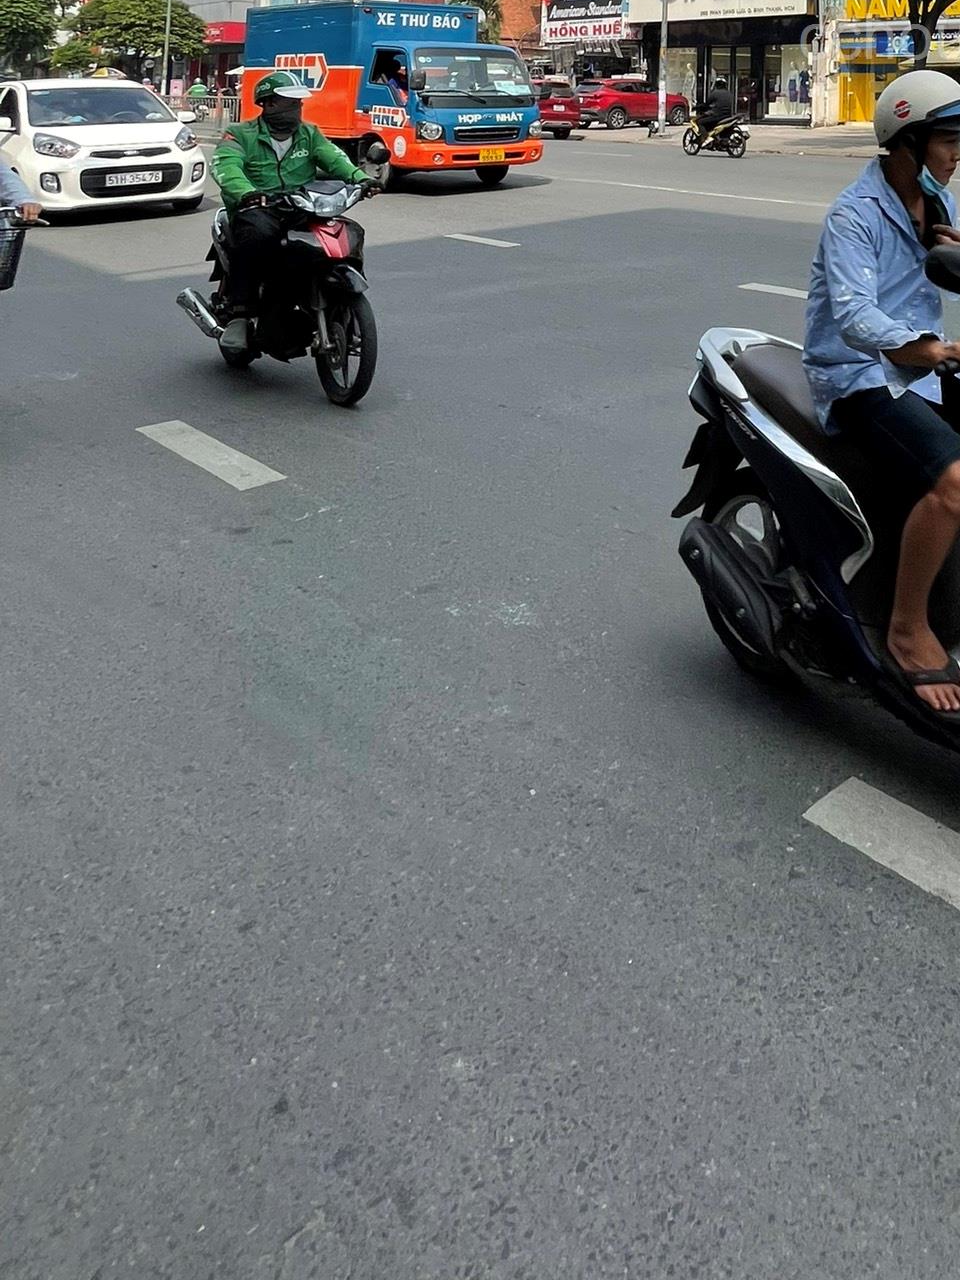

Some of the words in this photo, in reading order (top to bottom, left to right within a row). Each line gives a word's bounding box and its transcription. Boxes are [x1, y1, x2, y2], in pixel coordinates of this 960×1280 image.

[377, 12, 396, 26] XE
[400, 13, 431, 28] THƯ
[432, 13, 461, 29] BÁO
[550, 22, 588, 37] HỒNG
